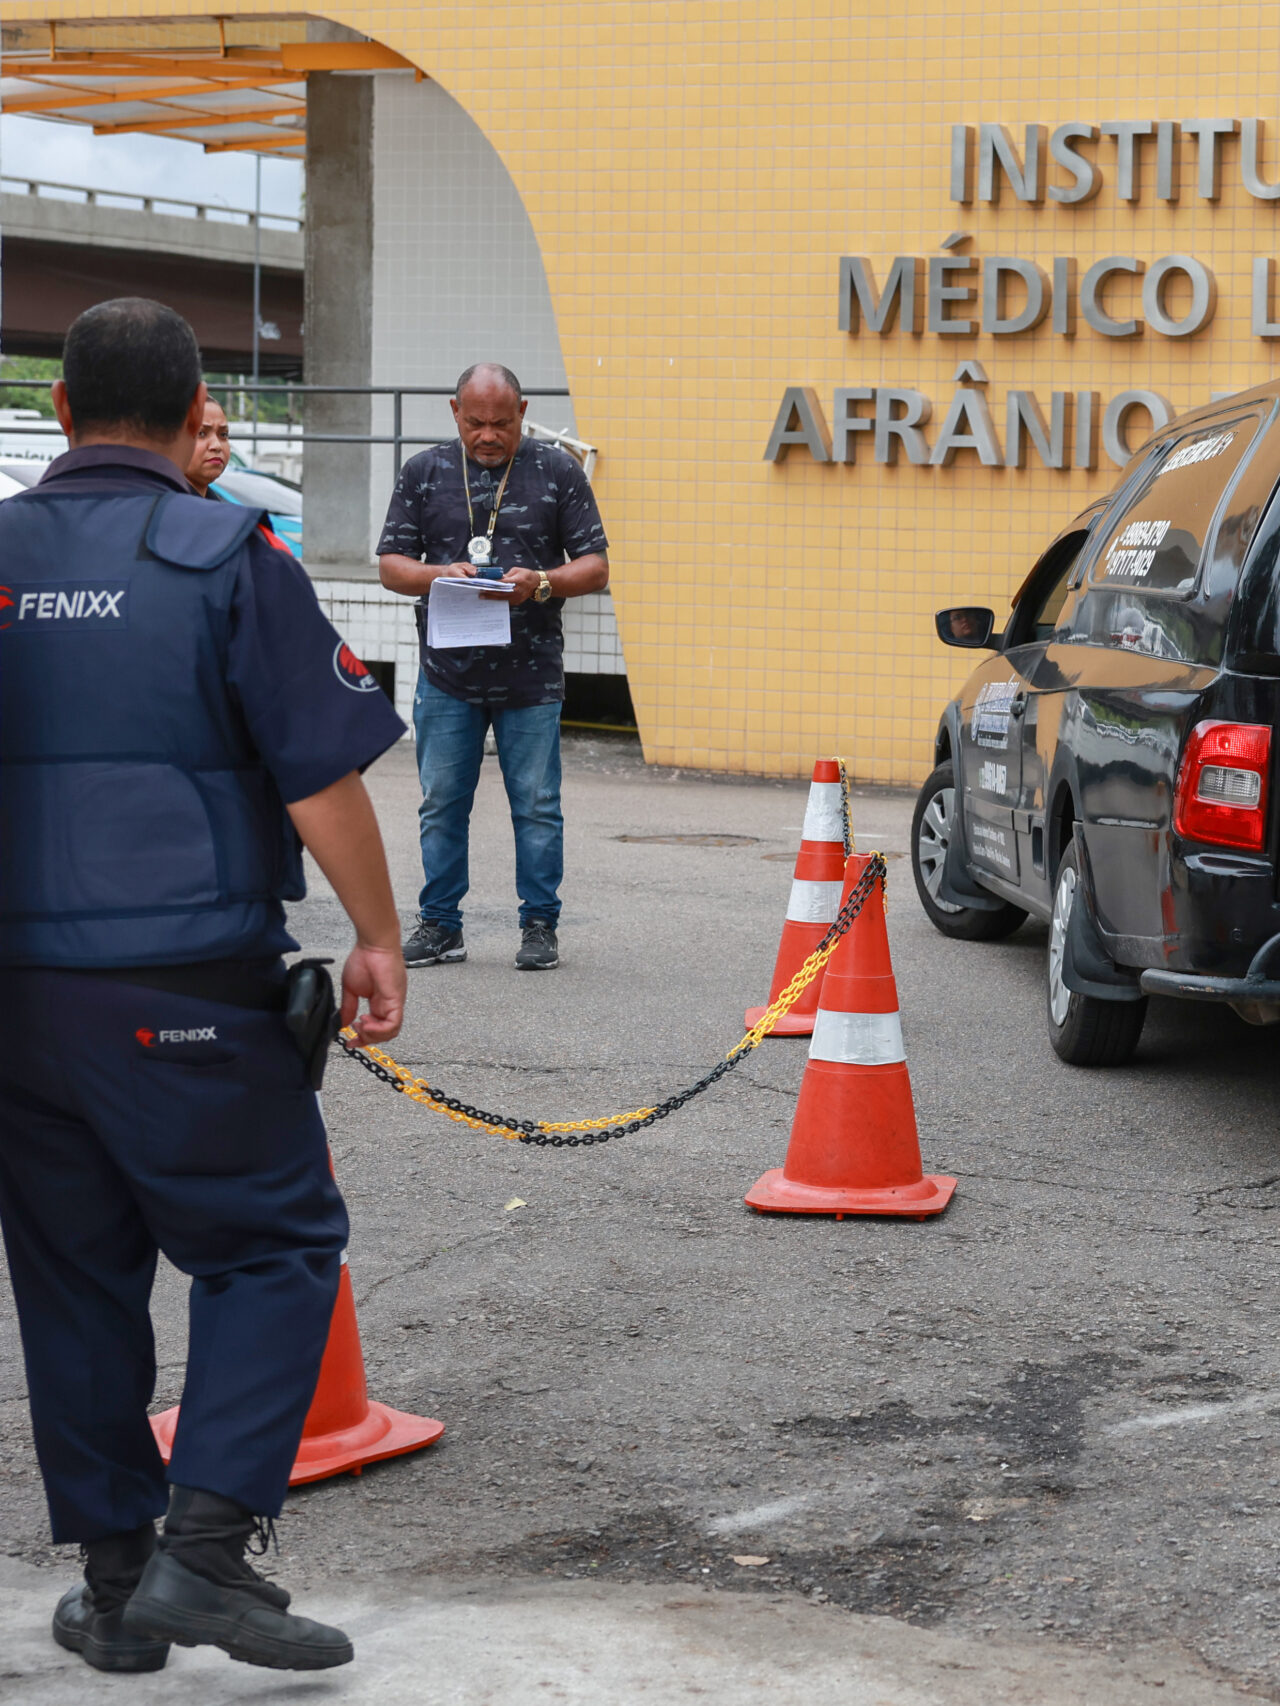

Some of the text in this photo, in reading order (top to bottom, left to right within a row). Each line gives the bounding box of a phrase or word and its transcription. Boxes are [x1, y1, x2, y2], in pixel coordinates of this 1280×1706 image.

[838, 232, 1218, 338] MÉDICO
[763, 360, 1178, 470] AFRÂNIO
[18, 590, 125, 620] FENIXX
[160, 1026, 218, 1043] FENIXX
